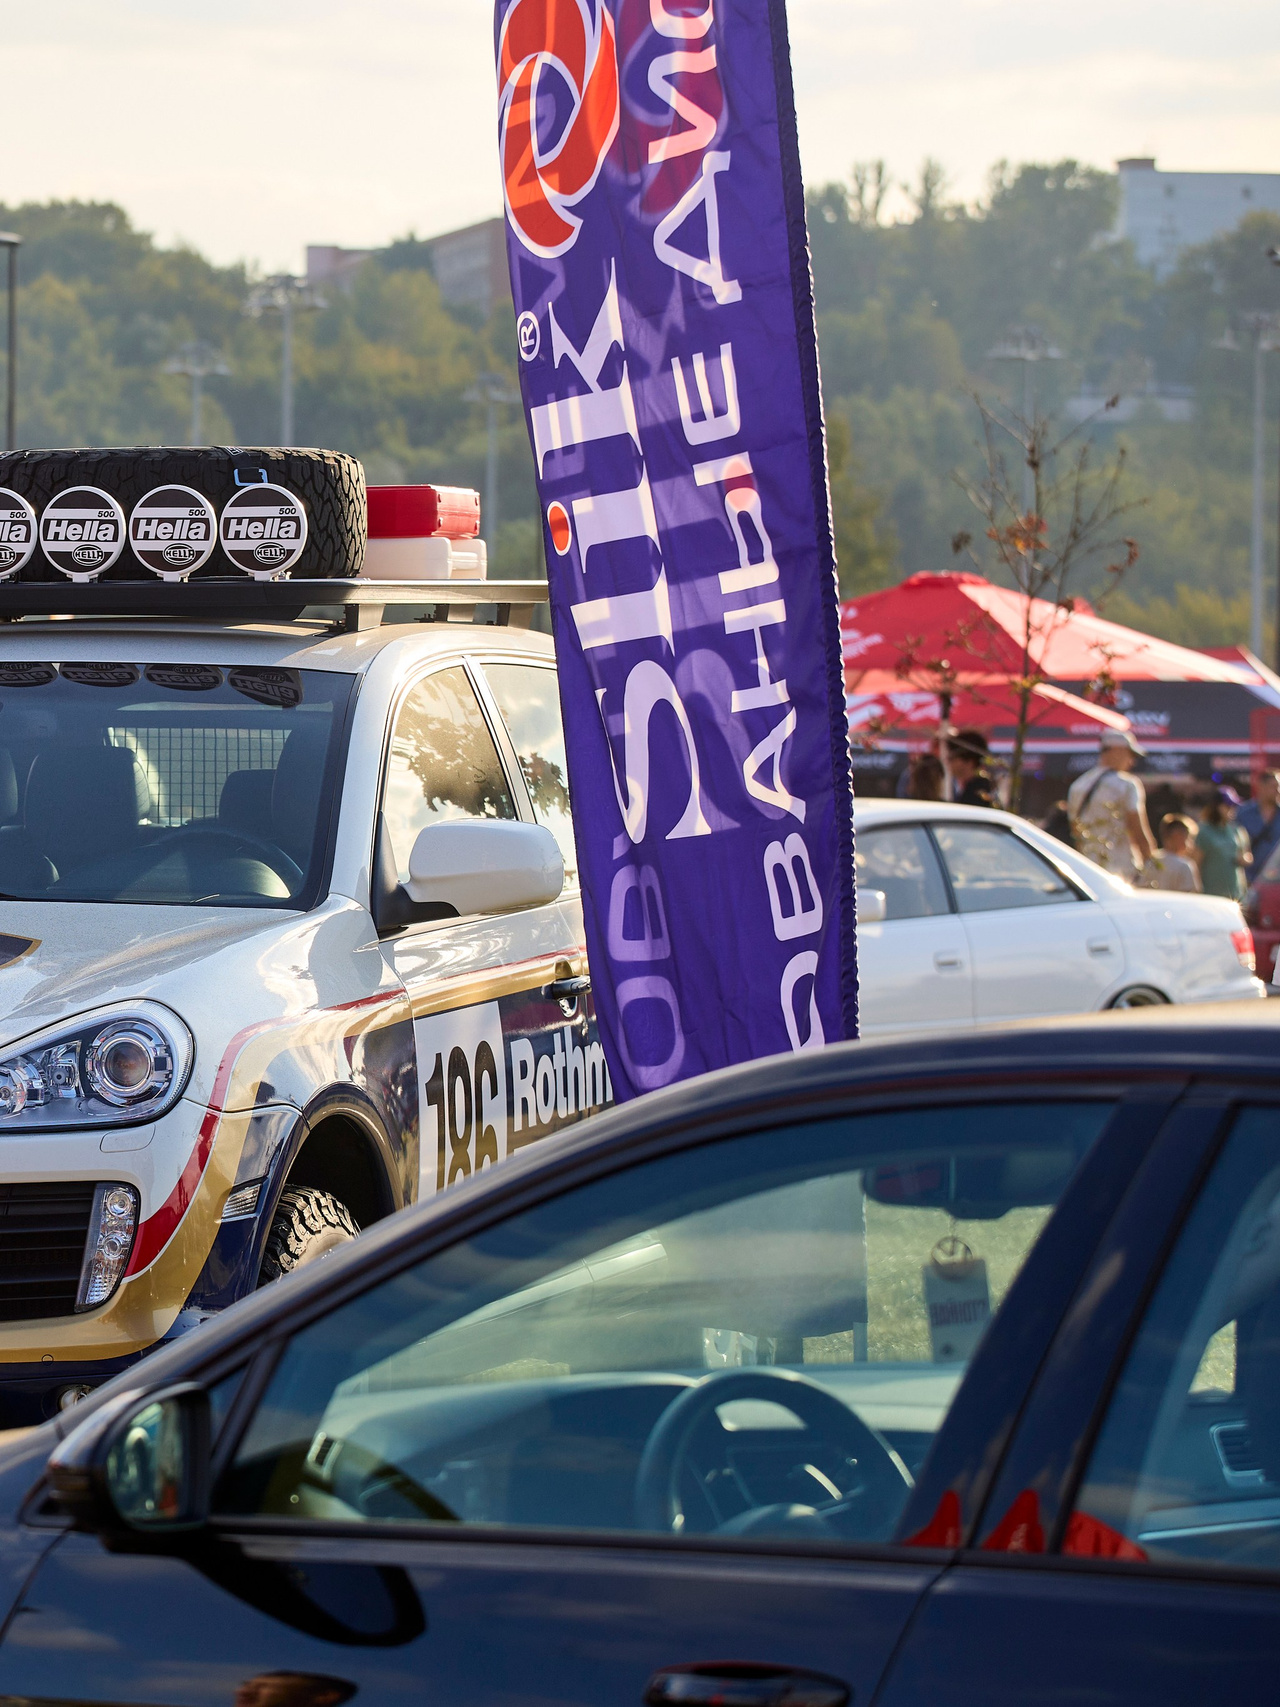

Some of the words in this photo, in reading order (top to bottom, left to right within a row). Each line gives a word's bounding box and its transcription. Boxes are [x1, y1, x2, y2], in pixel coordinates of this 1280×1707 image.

[9, 511, 27, 519] 500
[97, 510, 115, 518] 500
[188, 509, 207, 517] 500
[278, 507, 297, 515] 500
[46, 520, 115, 541] Hella
[136, 519, 207, 540] Hella
[227, 518, 297, 539] Hella
[74, 550, 104, 559] HELLA
[165, 549, 195, 558] HELLA
[256, 548, 286, 557] HELLA
[425, 1040, 498, 1195] 186
